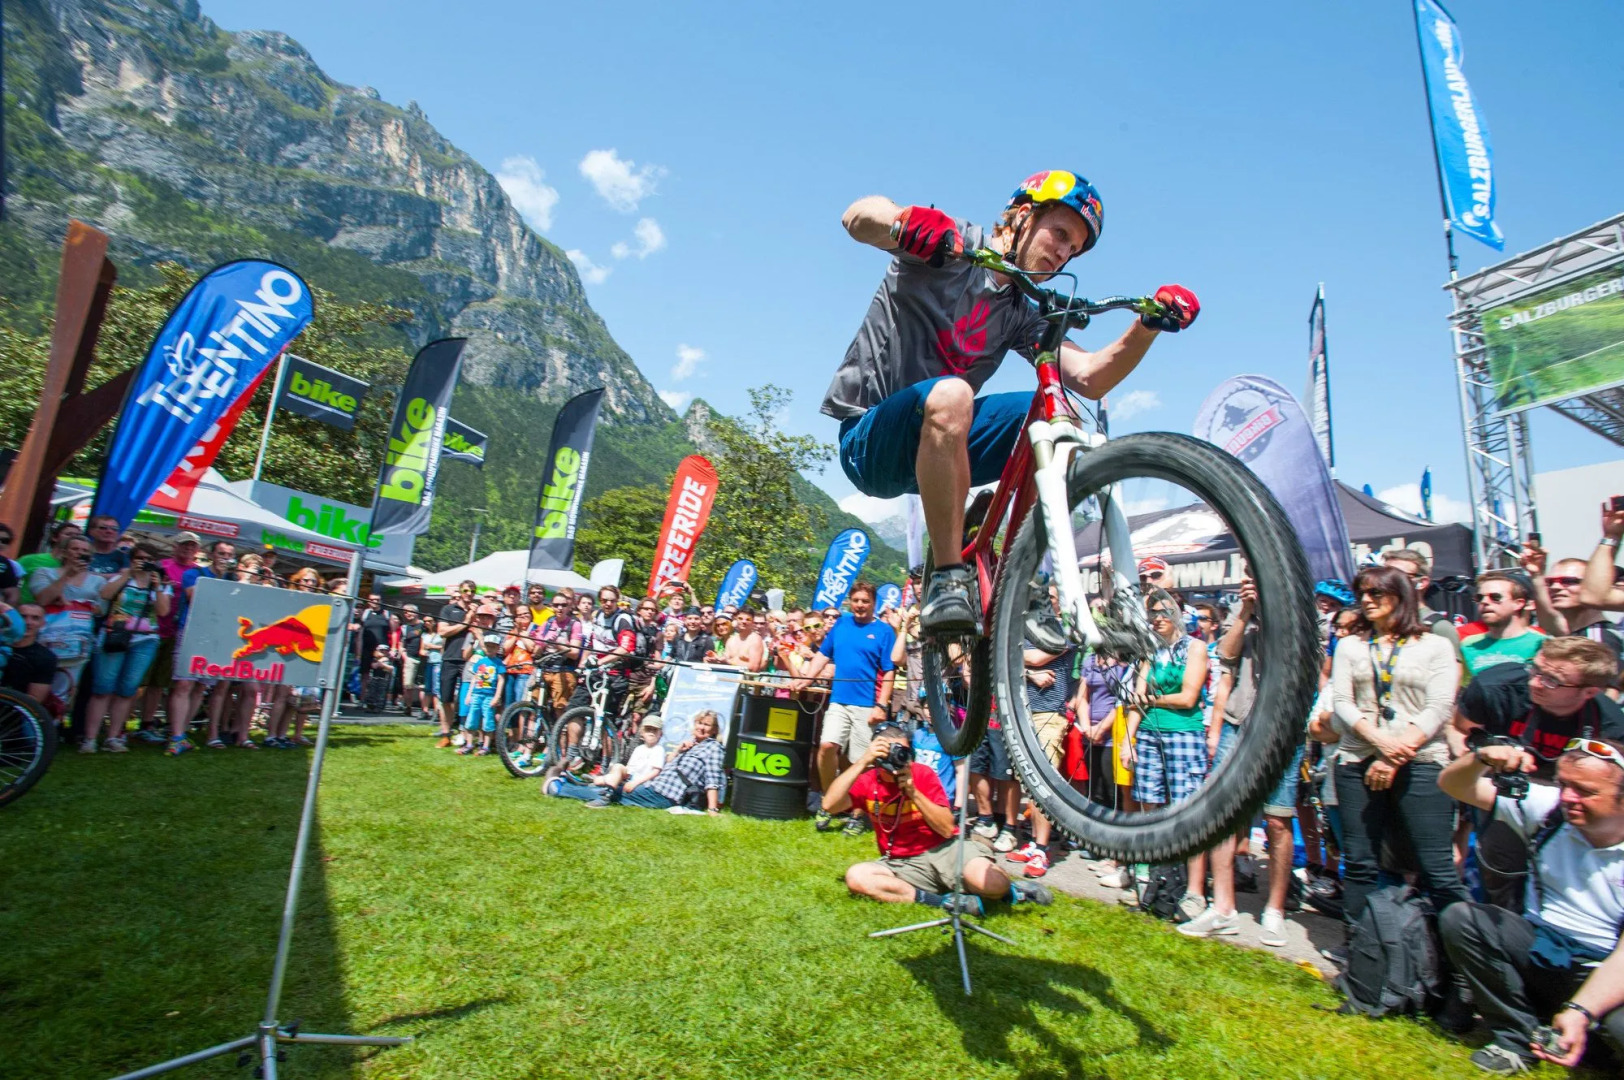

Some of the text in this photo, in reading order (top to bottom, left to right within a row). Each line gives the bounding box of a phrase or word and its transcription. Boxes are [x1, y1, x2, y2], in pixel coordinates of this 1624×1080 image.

[136, 270, 302, 425] TRENTINO
[289, 371, 358, 413] bike
[380, 398, 437, 504] bike
[535, 446, 580, 538] bike
[816, 531, 867, 607] TRENTINO
